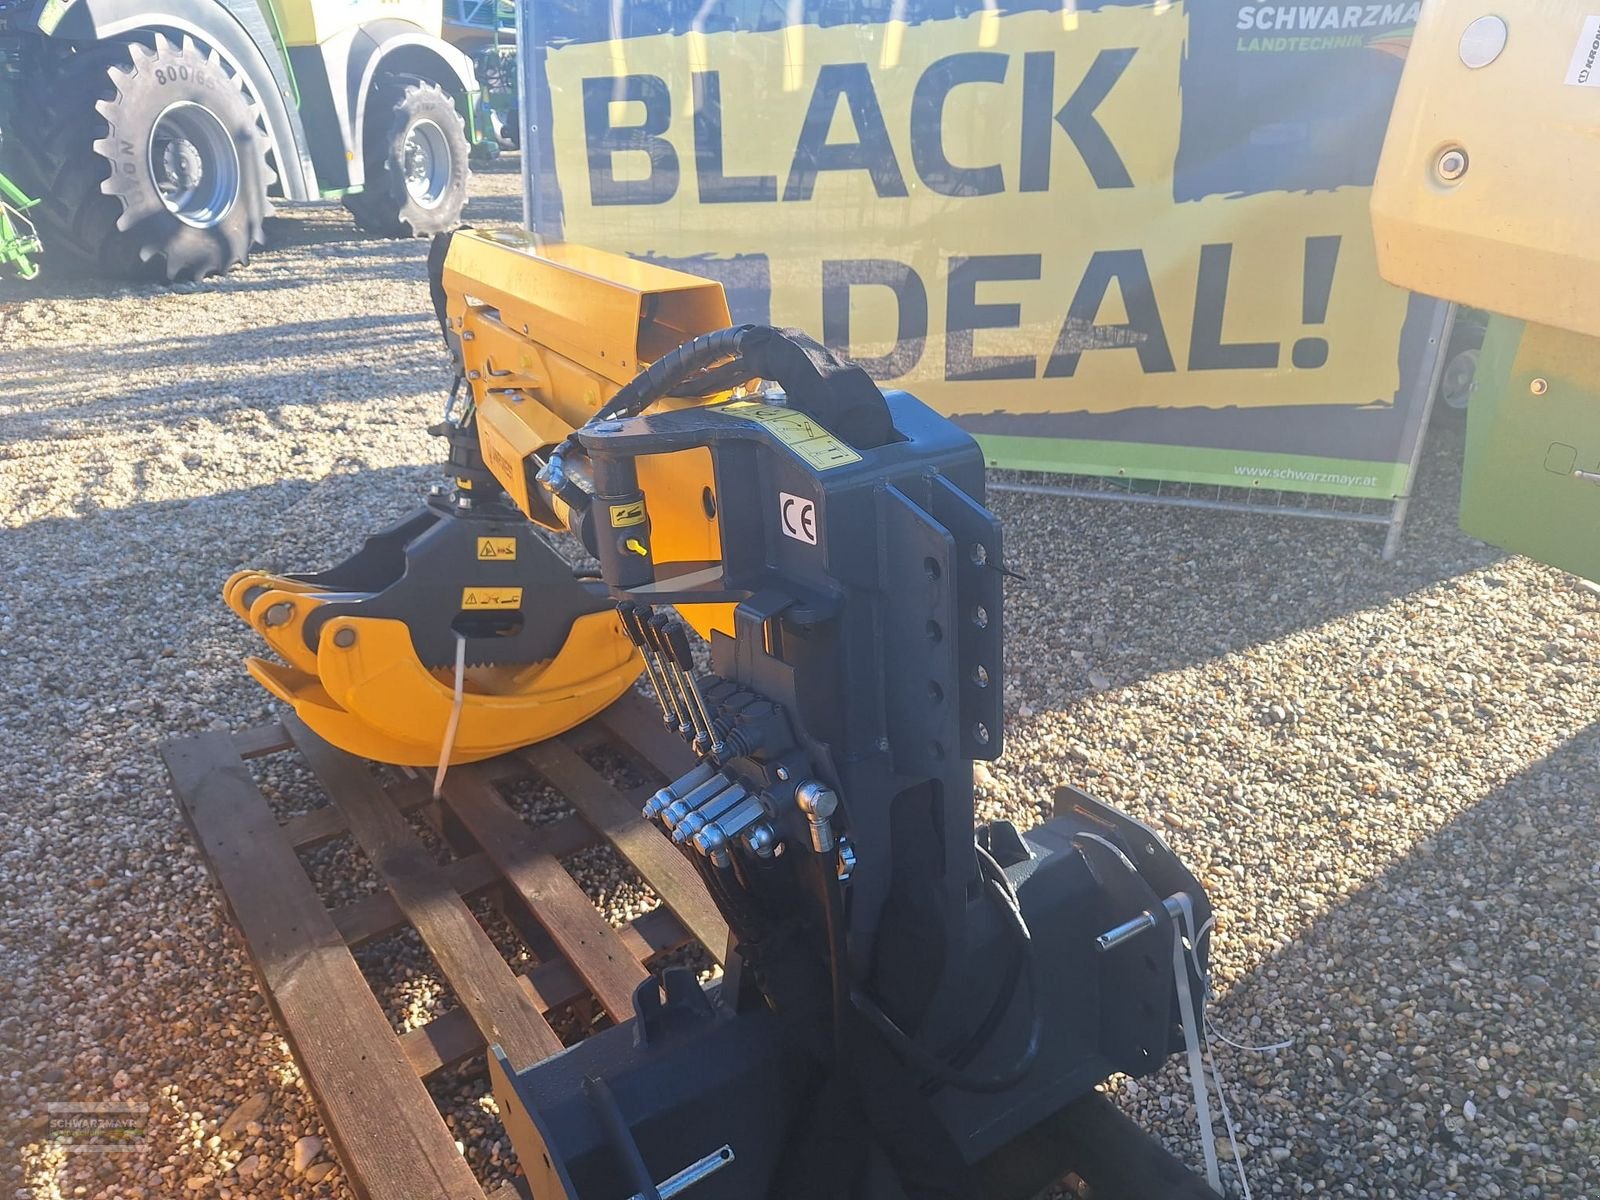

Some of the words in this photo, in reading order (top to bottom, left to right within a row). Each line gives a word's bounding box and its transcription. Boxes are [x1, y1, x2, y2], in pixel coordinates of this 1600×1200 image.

[1236, 34, 1365, 51] LANDTECHNIK
[581, 47, 1139, 206] BLACK
[821, 235, 1342, 382] DEAL!
[1234, 464, 1377, 487] www.schwarzmayr.at
[783, 499, 814, 541] CE
